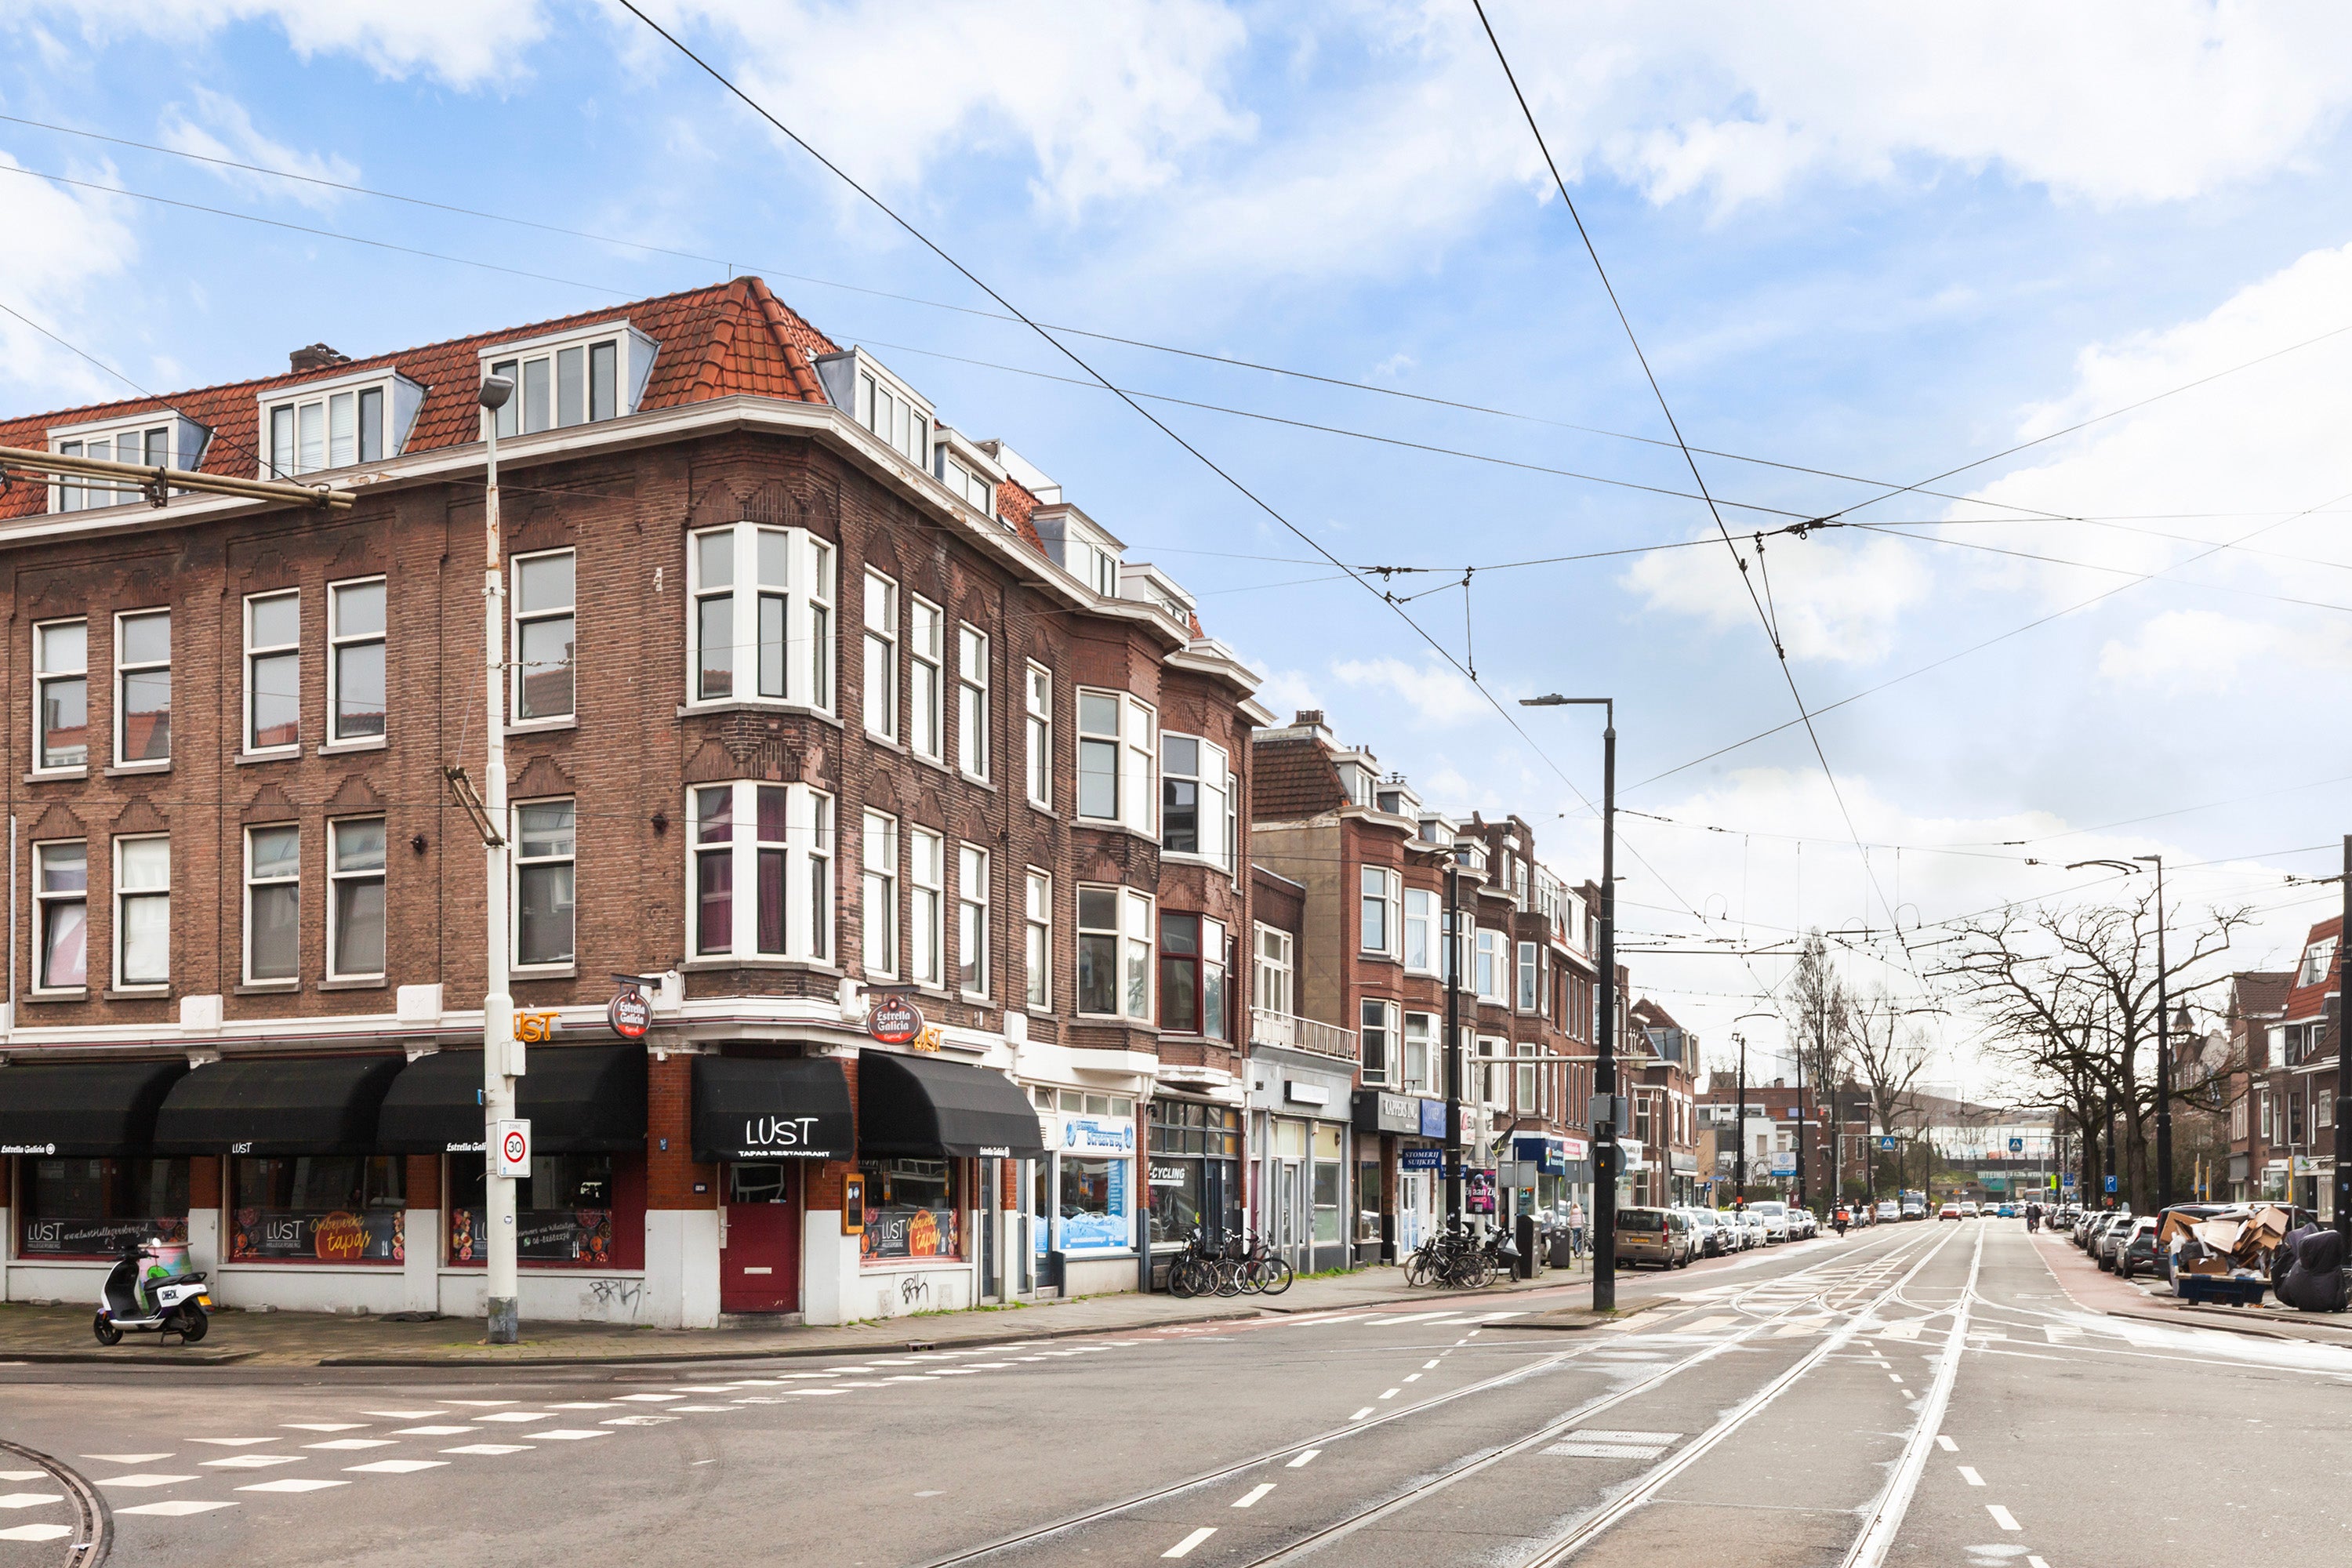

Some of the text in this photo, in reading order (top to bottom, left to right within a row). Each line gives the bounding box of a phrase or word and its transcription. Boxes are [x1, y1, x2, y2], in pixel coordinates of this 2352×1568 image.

[619, 1001, 645, 1015] Estrella
[877, 1011, 911, 1021] Estrella
[514, 1011, 559, 1043] UST
[620, 1013, 644, 1025] Galicia
[877, 1020, 909, 1032] Galicia
[746, 1116, 818, 1145] LUST
[1, 1145, 45, 1153] Estrella Galicia
[232, 1142, 252, 1153] LUST
[446, 1142, 486, 1152] Estrella Gali
[508, 1141, 522, 1153] 30
[28, 1222, 64, 1241] LUST
[266, 1220, 304, 1240] LUST
[309, 1214, 365, 1233] Onbeperkt
[881, 1219, 906, 1240] LUST
[326, 1230, 372, 1258] tapas
[916, 1228, 942, 1254] tapas
